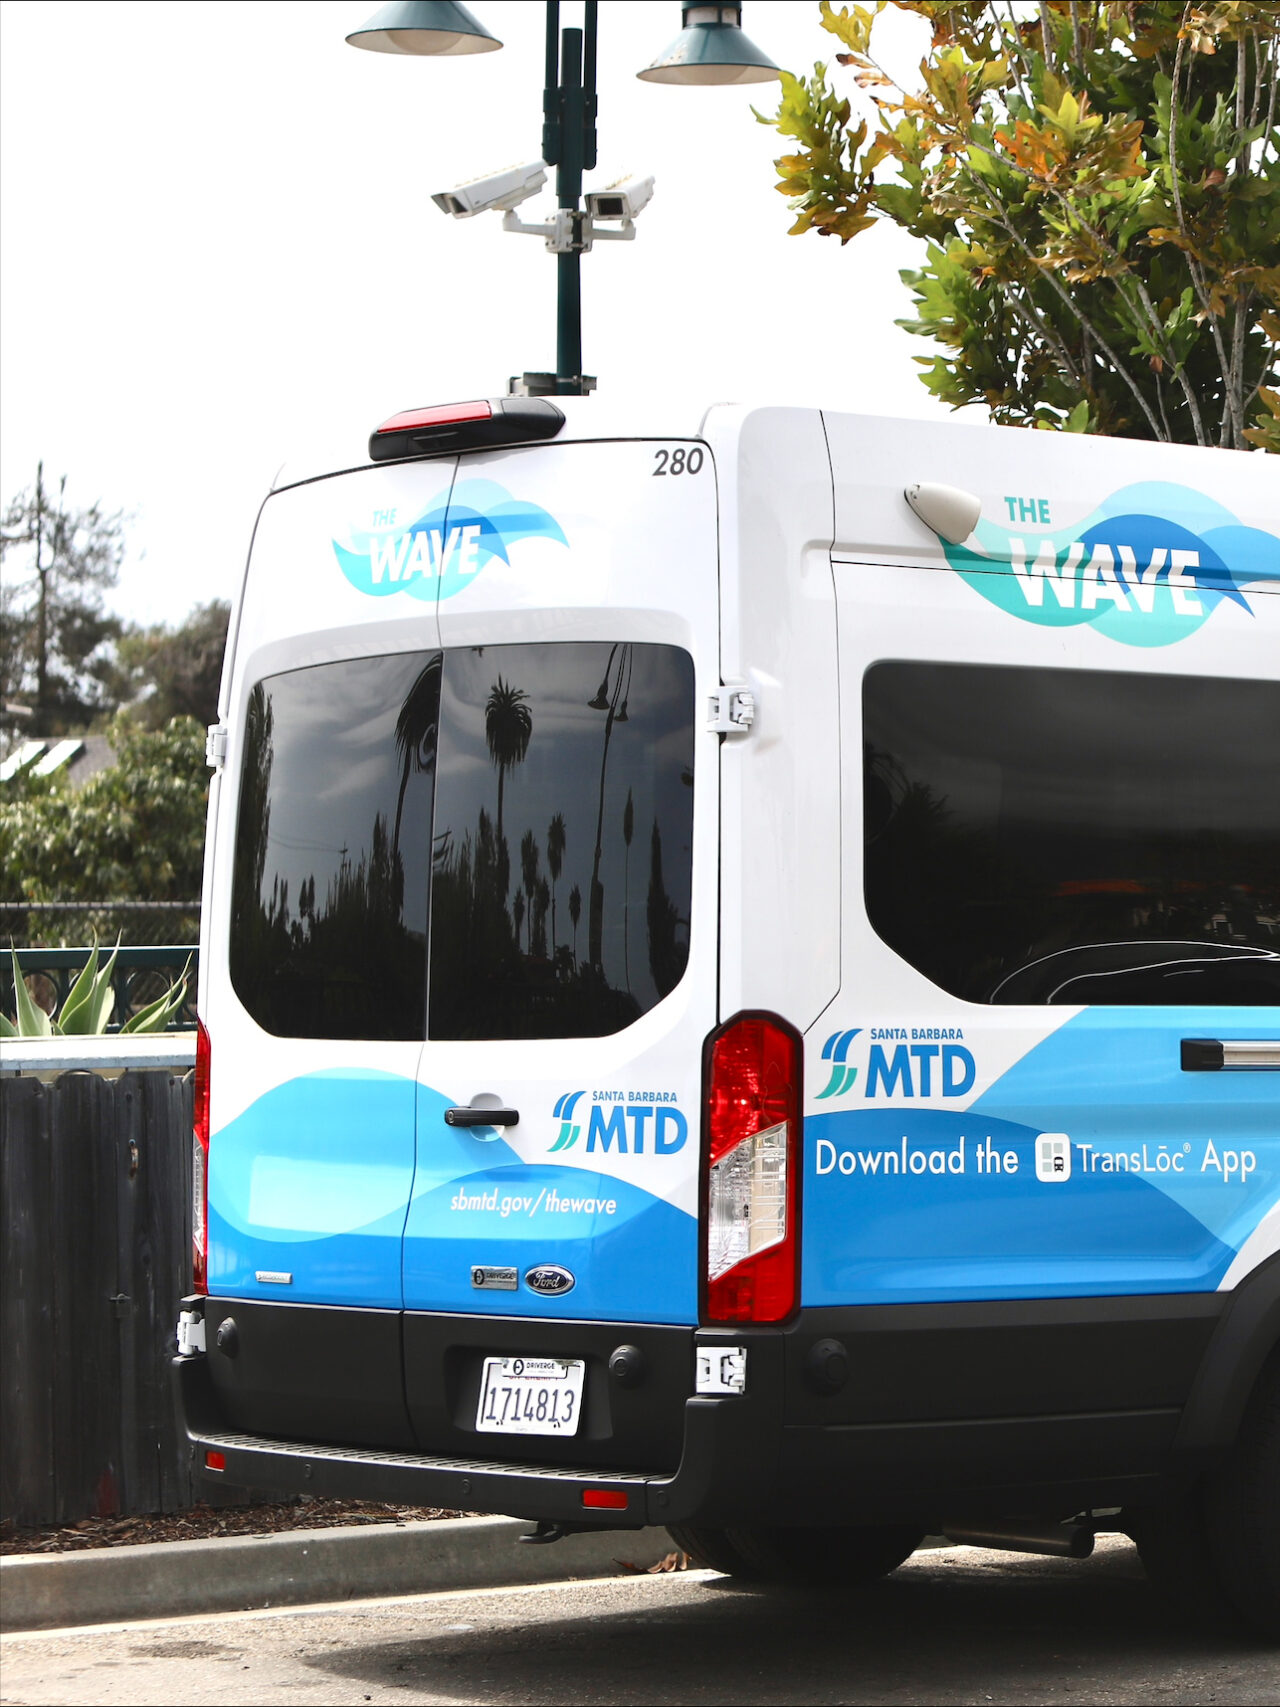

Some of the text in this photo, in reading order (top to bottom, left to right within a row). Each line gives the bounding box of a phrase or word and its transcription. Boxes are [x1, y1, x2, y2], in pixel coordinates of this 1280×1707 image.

[652, 447, 702, 476] 280
[373, 507, 397, 527] THE
[1004, 496, 1051, 524] THE
[368, 524, 483, 584] WAVE
[1008, 537, 1203, 616] WAVE
[870, 1028, 964, 1041] SANTA BARBARA
[864, 1044, 976, 1098] MTD
[592, 1090, 678, 1103] SANTA BARBARA
[586, 1105, 688, 1154] MTD
[815, 1135, 968, 1175] Download
[975, 1135, 1019, 1174] the
[1200, 1137, 1257, 1183] App
[450, 1186, 617, 1218] sbmtd.gov/thewave
[532, 1270, 561, 1289] Ford
[486, 1387, 575, 1423] 1714813
